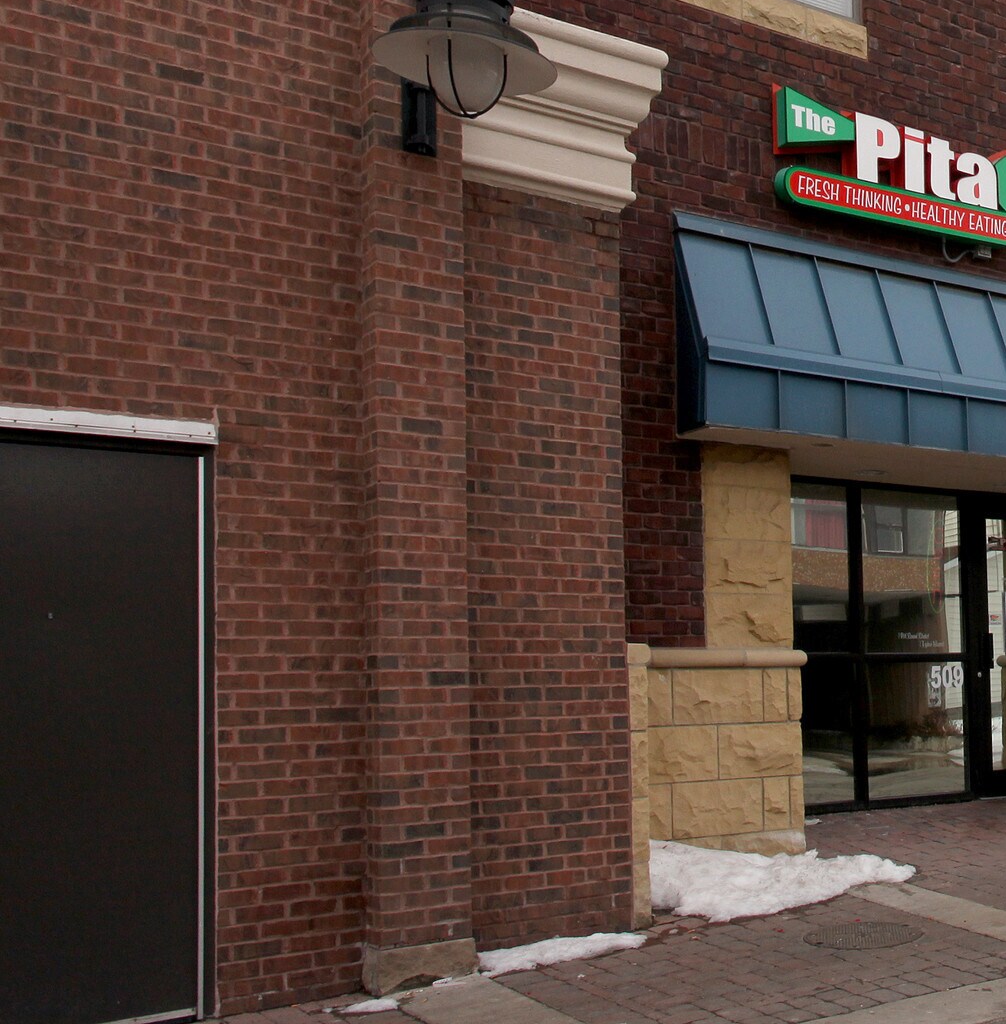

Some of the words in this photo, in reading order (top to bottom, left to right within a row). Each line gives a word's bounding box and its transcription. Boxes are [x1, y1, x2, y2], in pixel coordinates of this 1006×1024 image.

[791, 103, 836, 135] The
[855, 111, 998, 211] Pita
[797, 175, 839, 201] FRESH
[845, 186, 902, 215] THINKING
[911, 203, 965, 231] HEALTHY
[931, 665, 964, 689] 509
